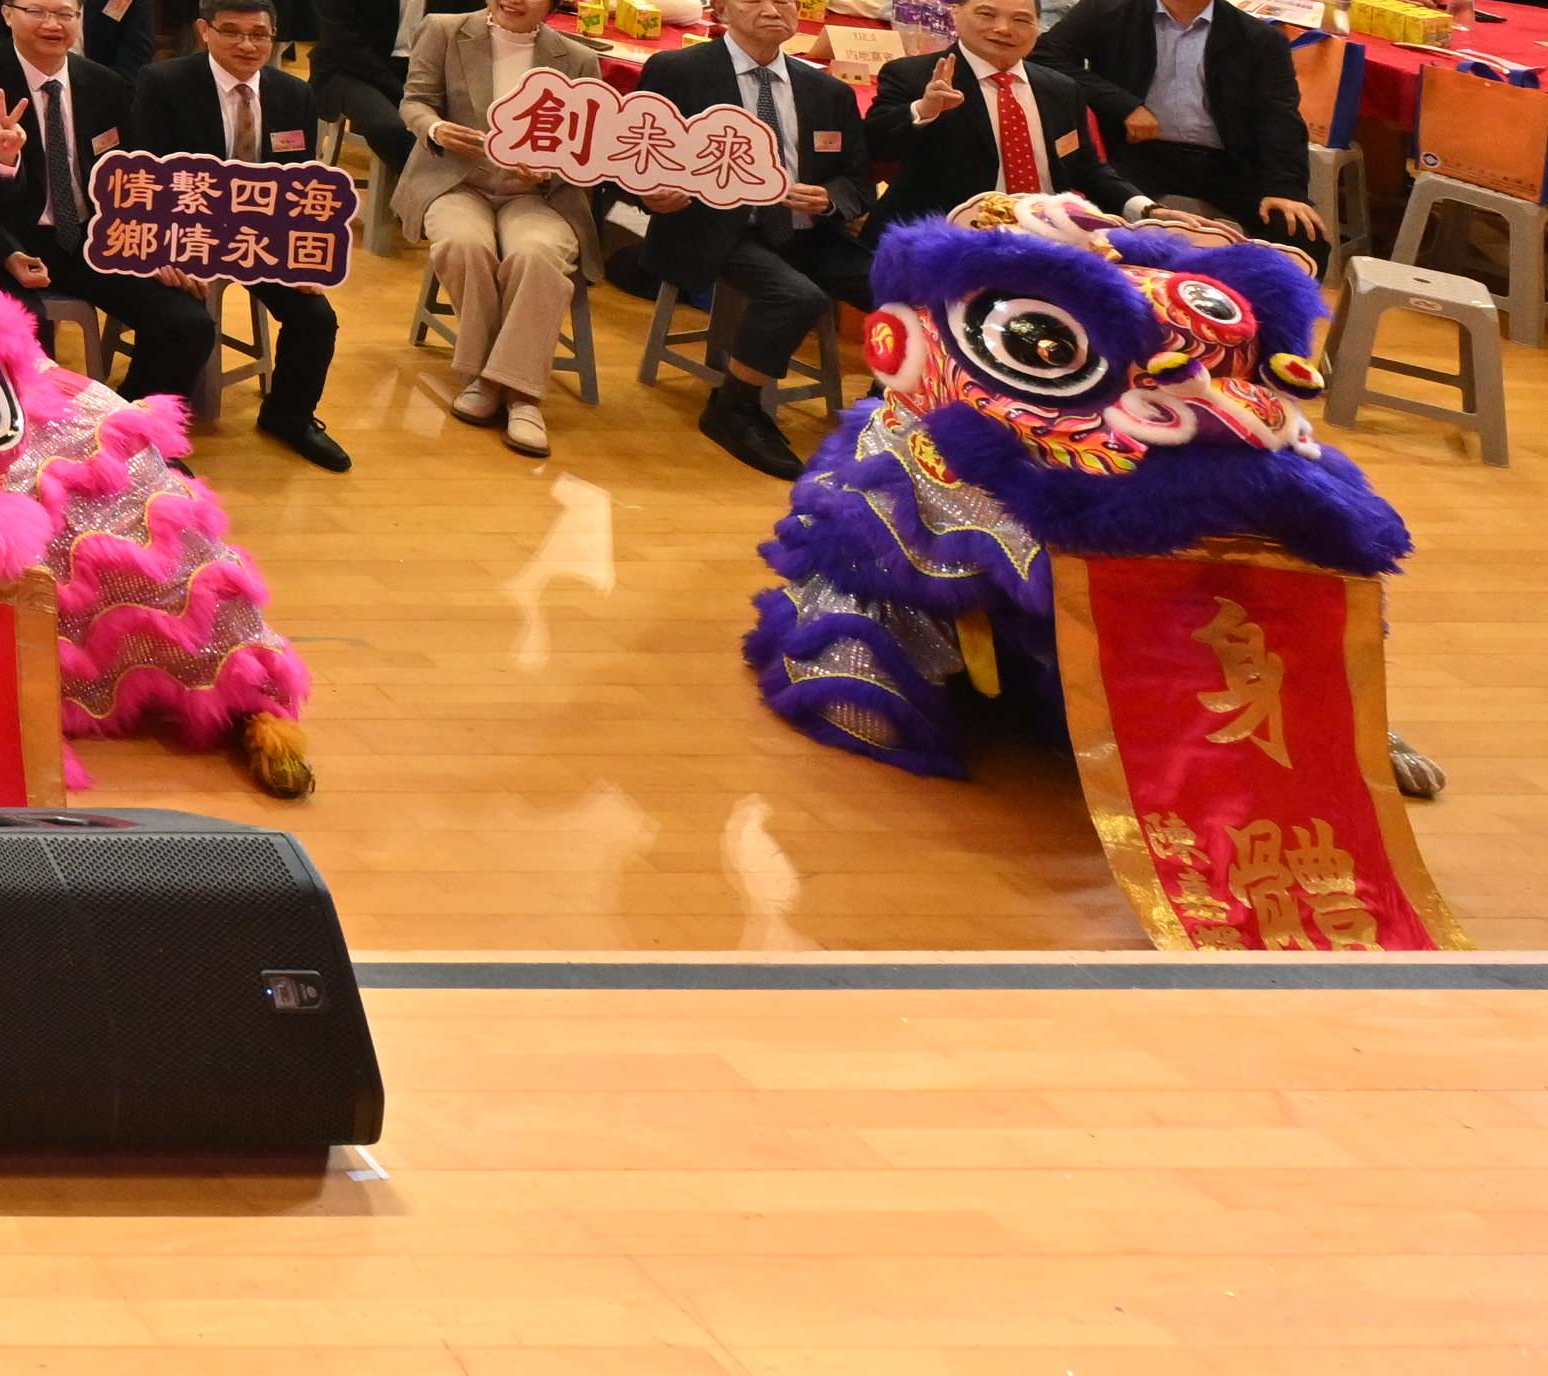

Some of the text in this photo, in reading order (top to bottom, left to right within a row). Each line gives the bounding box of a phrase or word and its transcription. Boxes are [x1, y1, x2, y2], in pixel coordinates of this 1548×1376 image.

[509, 88, 765, 189] 創未來
[107, 168, 343, 222] 情繫四海
[102, 219, 337, 273] 鄉情永固
